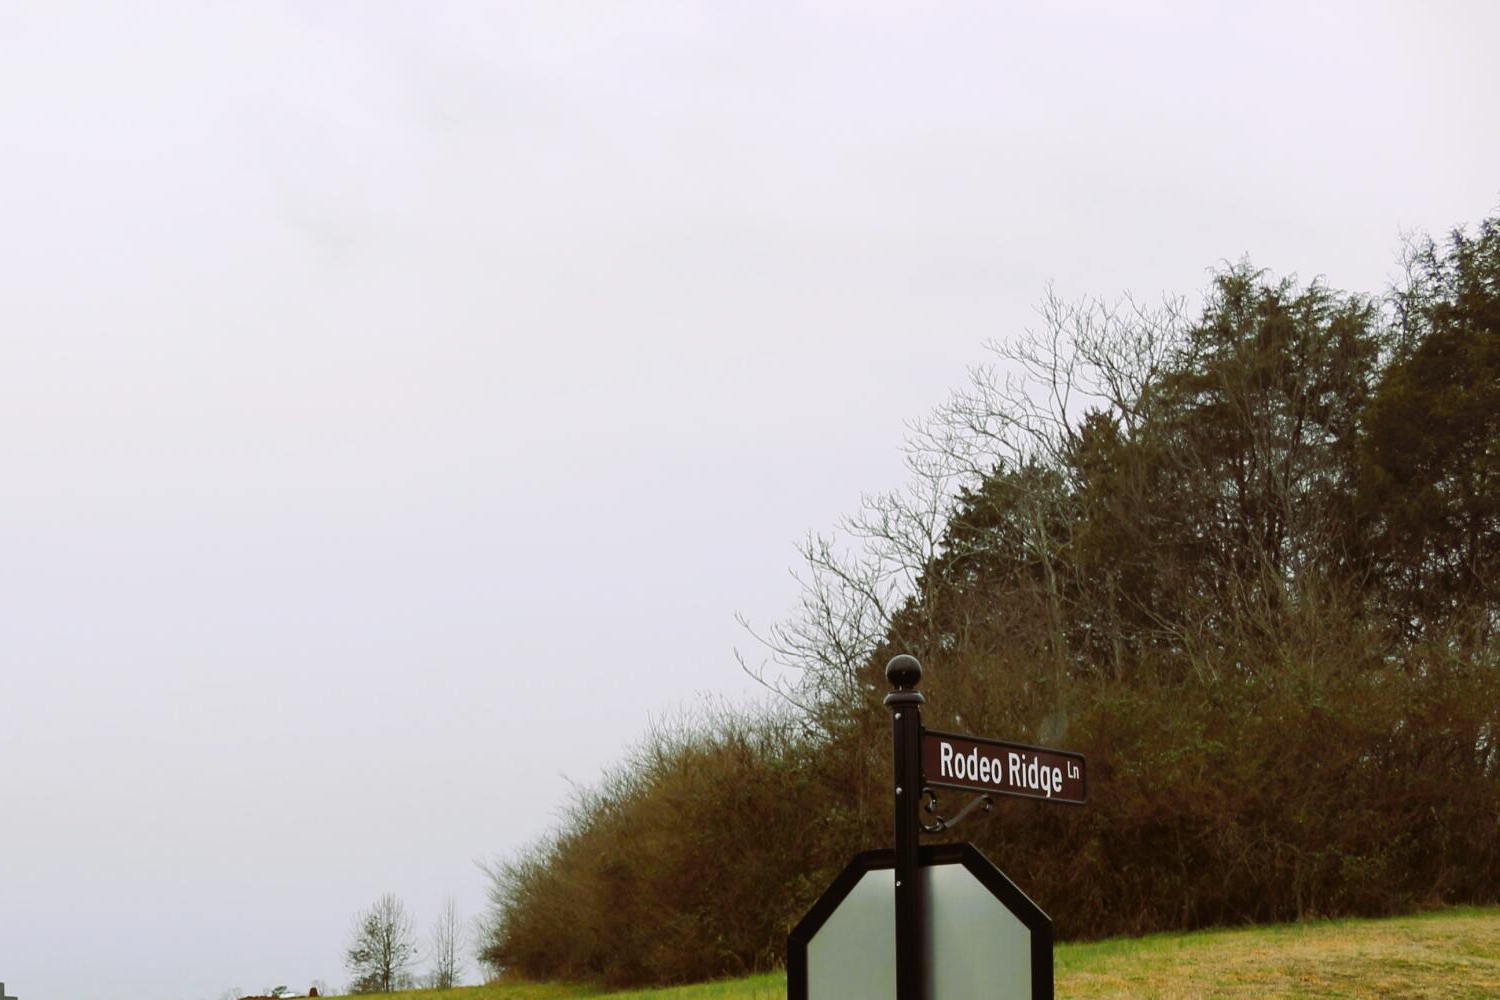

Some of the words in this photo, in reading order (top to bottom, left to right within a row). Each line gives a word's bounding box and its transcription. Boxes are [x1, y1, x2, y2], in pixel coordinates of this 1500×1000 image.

[940, 741, 1002, 784] Rodeo
[1008, 752, 1063, 798] Ridge
[1067, 761, 1080, 779] Ln
